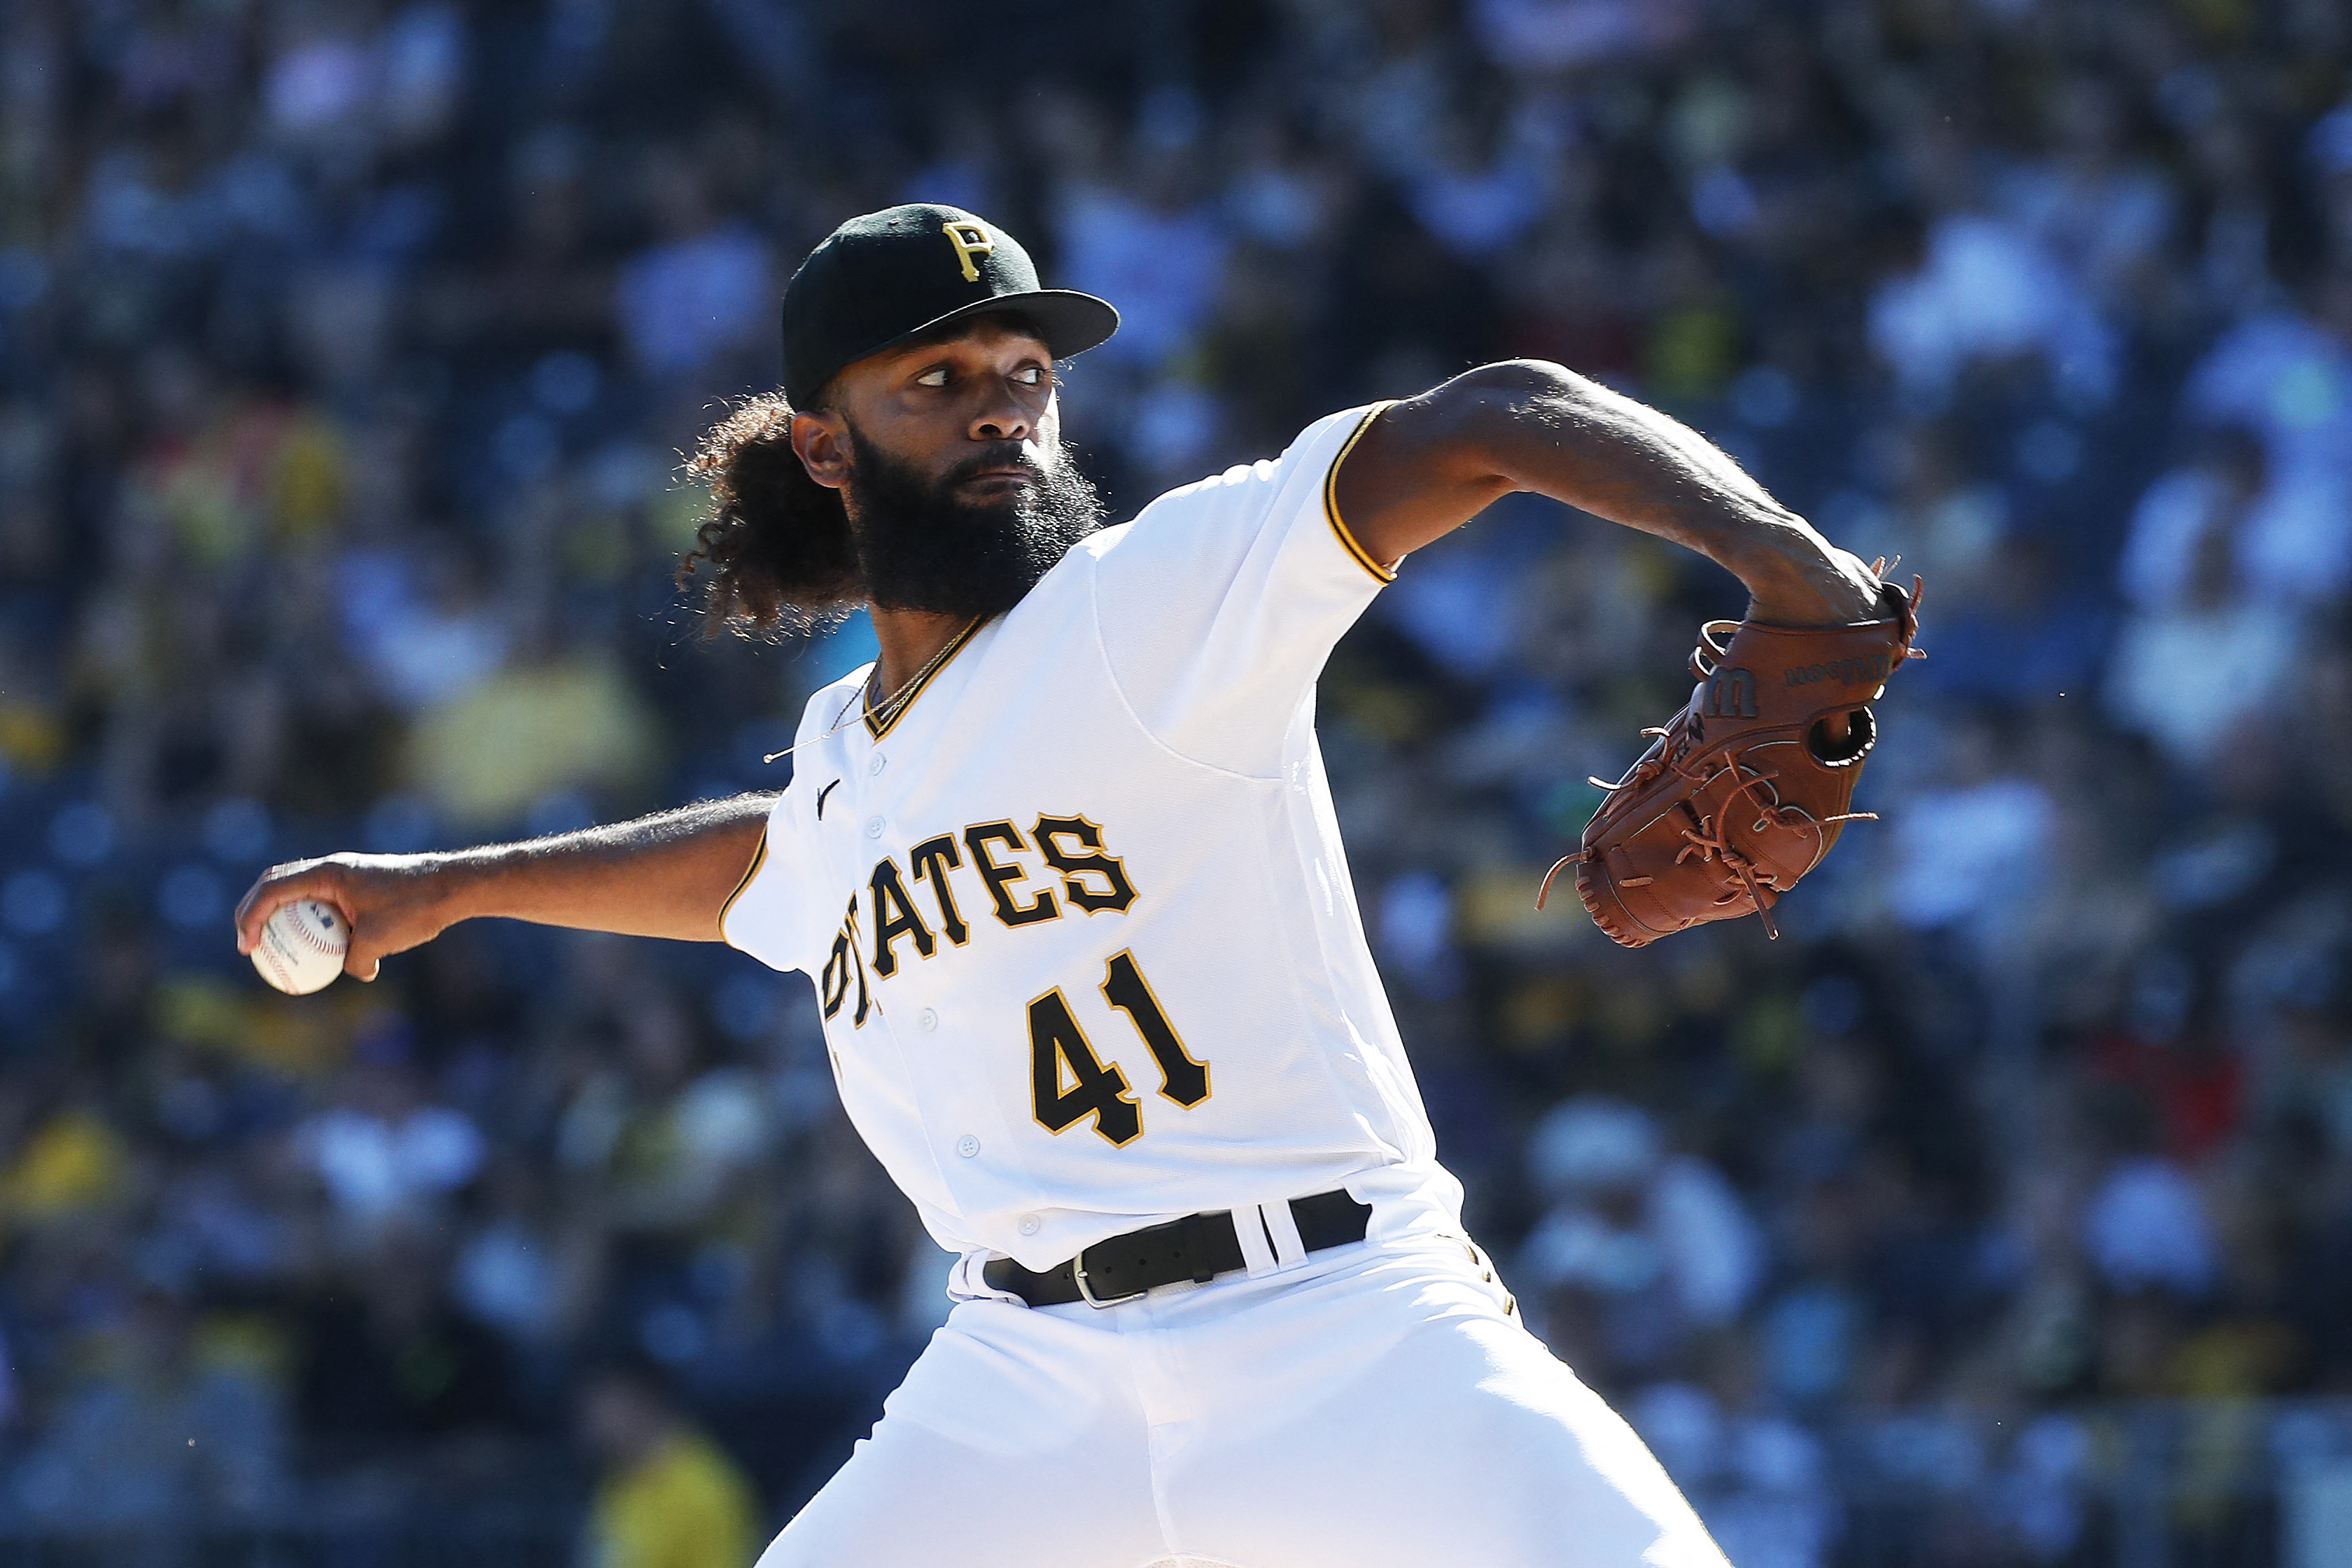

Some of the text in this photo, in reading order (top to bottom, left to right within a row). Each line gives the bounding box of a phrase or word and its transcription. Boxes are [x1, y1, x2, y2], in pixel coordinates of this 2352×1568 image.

[941, 220, 995, 283] P
[1785, 652, 1891, 688] Wilson
[1026, 947, 1212, 1149] 41
